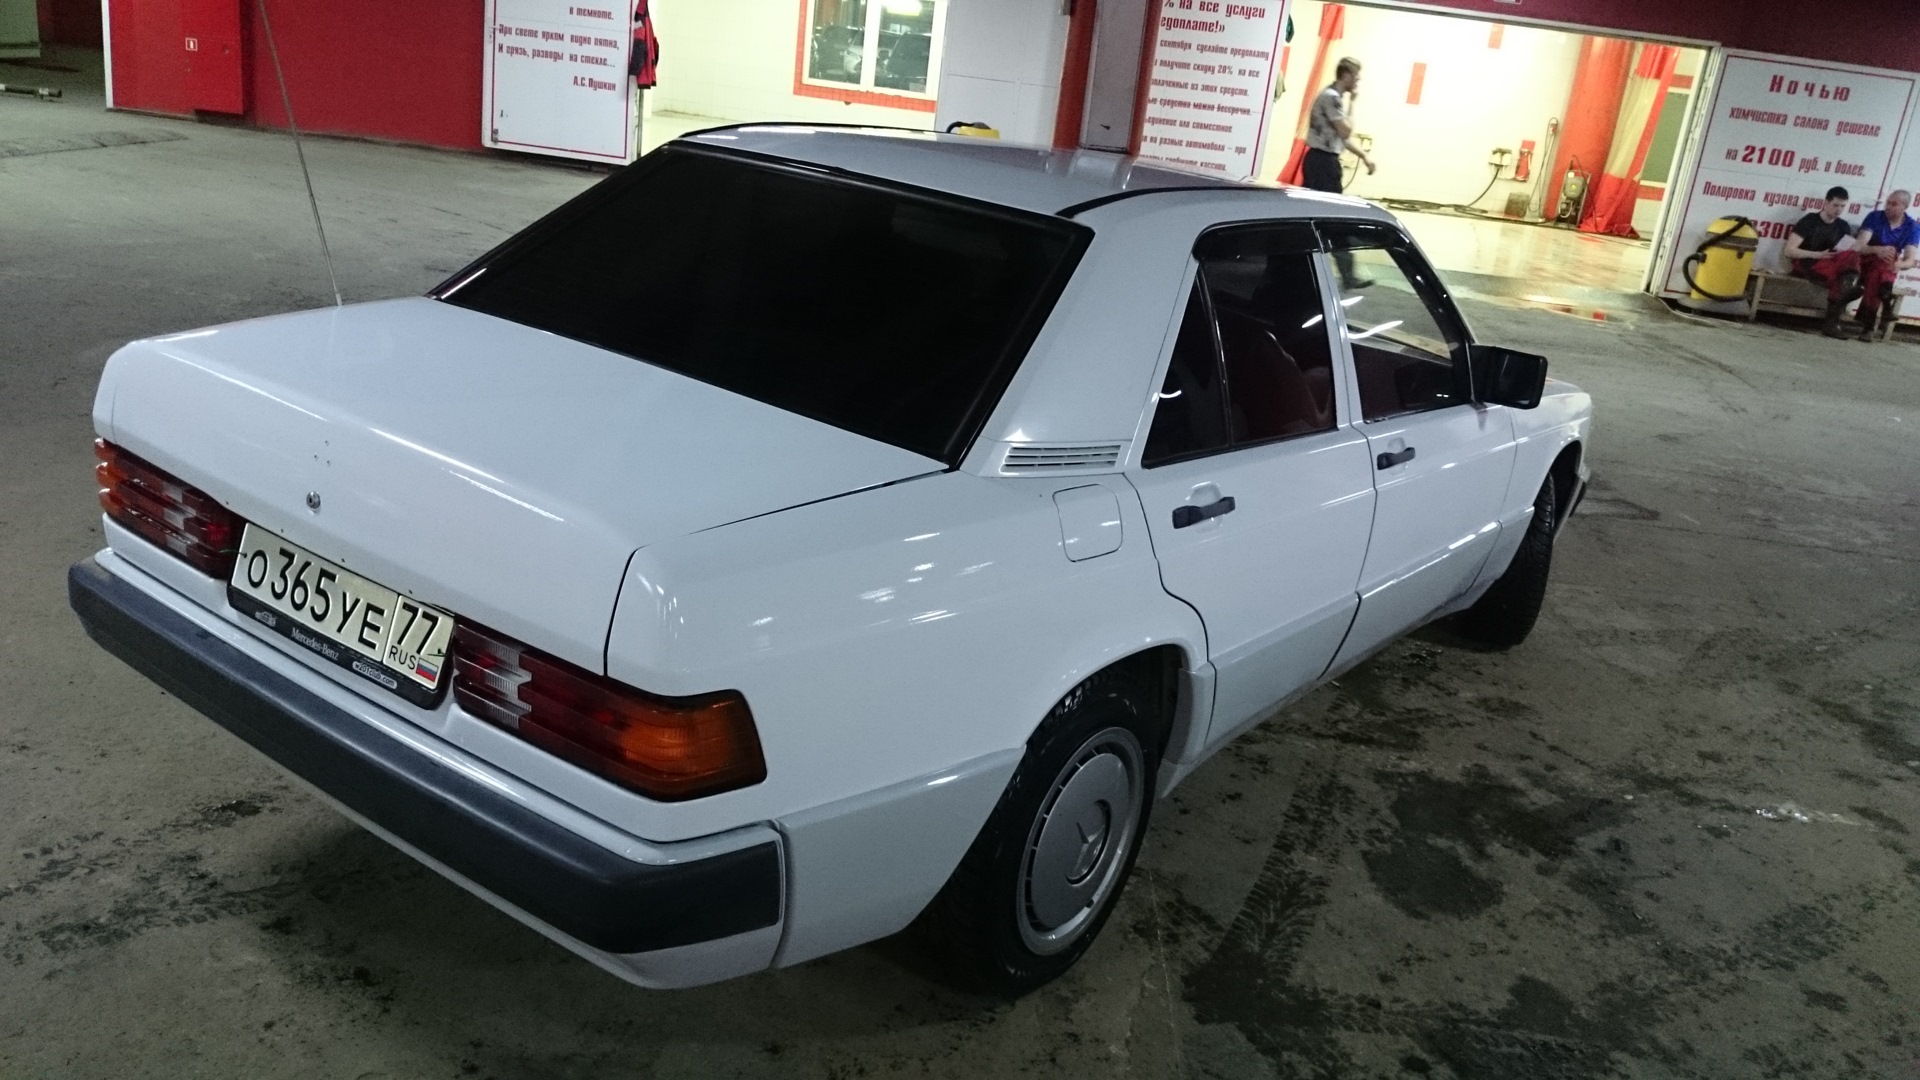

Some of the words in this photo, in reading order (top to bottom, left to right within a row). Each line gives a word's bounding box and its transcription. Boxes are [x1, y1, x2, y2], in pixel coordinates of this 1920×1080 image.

[569, 6, 574, 15] в
[576, 7, 614, 20] темноте.
[1179, 0, 1192, 10] на
[1199, 1, 1219, 13] все
[1225, 4, 1266, 20] услуги
[499, 24, 512, 37] При
[515, 27, 538, 38] свете
[541, 31, 564, 42] ярком
[570, 34, 591, 46] видно
[594, 37, 619, 50] пятна,
[1160, 39, 1192, 51] сентября
[1196, 43, 1228, 54] сделайте
[1230, 47, 1269, 61] предоплату
[498, 43, 503, 53] И
[506, 45, 529, 58] грязь,
[532, 49, 564, 62] разводы
[569, 53, 578, 62] на
[1159, 59, 1191, 70] получите
[1193, 62, 1215, 74] скидку
[1217, 64, 1233, 75] 20%
[1237, 68, 1246, 77] на
[1248, 69, 1260, 78] все
[588, 77, 616, 91] Пушкин
[1769, 74, 1851, 101] Ночью
[1729, 107, 1788, 125] химчистка
[1793, 115, 1830, 130] салона
[1835, 120, 1882, 137] дешевле
[1725, 148, 1739, 161] на
[1741, 145, 1796, 168] 2100
[1798, 156, 1820, 173] руб.
[1824, 161, 1832, 172] и
[1834, 159, 1866, 178] более.
[1702, 181, 1756, 201] Полировка
[1763, 191, 1800, 208] кузова
[1848, 203, 1861, 214] на
[396, 602, 439, 655] 77
[291, 627, 339, 660] Mercedes-Benz
[388, 644, 416, 671] RUS
